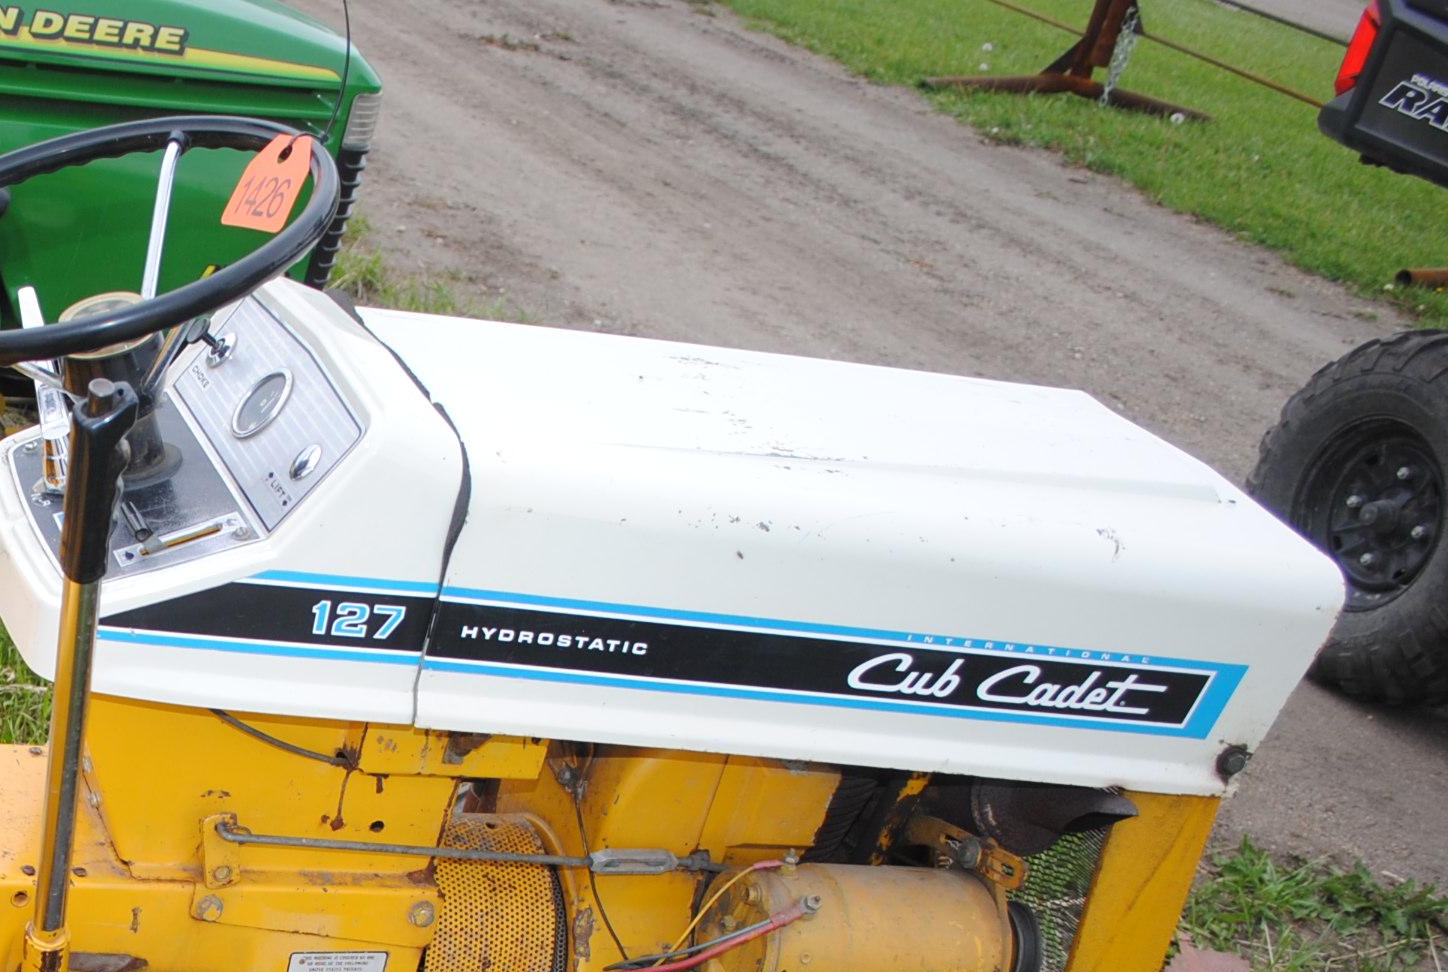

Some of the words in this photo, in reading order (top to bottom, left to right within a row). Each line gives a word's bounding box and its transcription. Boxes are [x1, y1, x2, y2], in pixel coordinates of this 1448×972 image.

[29, 9, 186, 54] DEERE
[1378, 81, 1448, 132] RA
[233, 174, 292, 218] 1426
[311, 600, 407, 640] 127
[460, 625, 648, 656] HYDROSTATIC
[906, 634, 1152, 665] INTERNATIONAL
[847, 652, 965, 698] Cub
[976, 664, 1168, 715] Cadet
